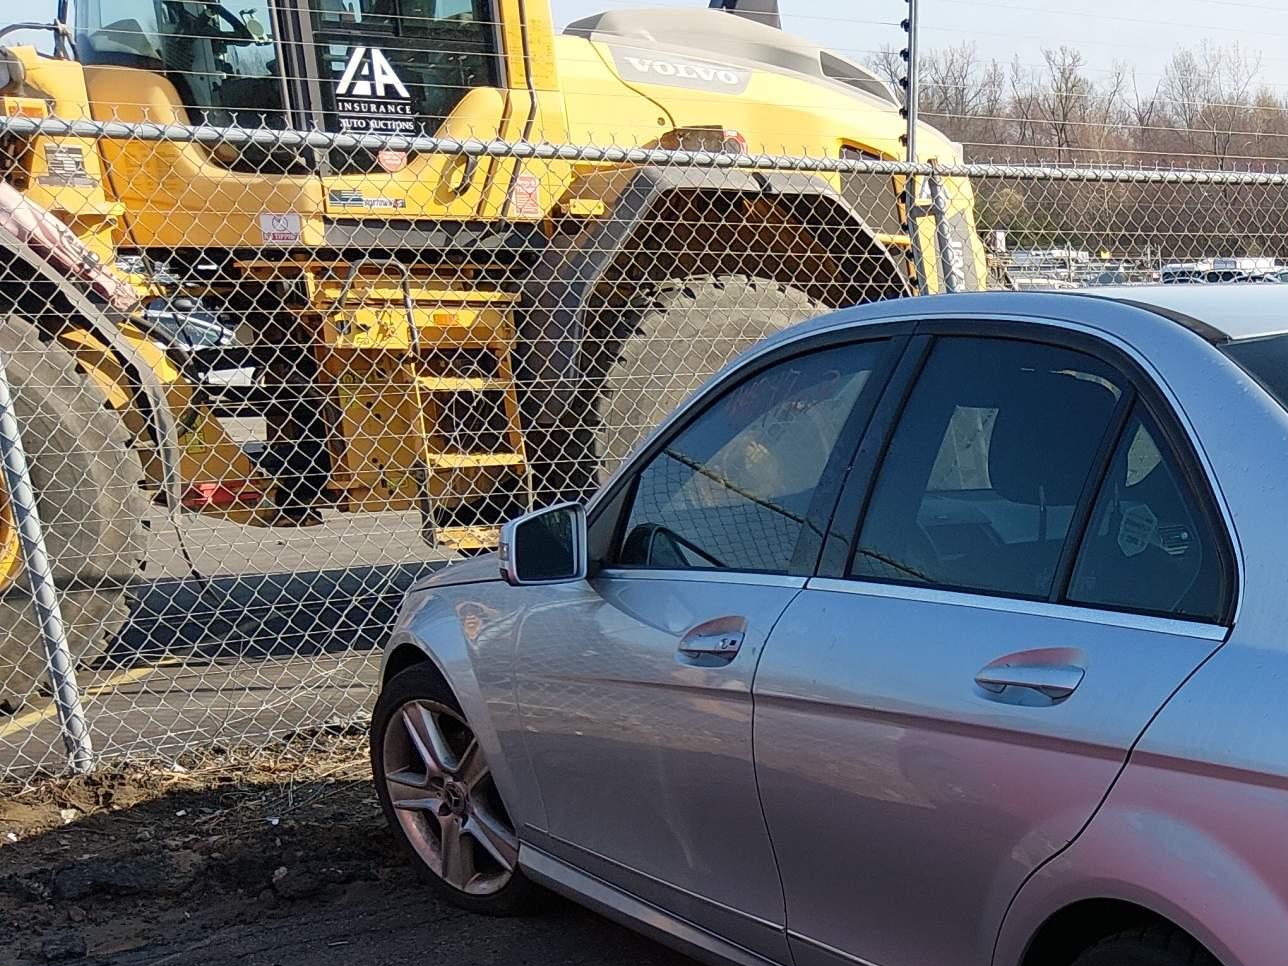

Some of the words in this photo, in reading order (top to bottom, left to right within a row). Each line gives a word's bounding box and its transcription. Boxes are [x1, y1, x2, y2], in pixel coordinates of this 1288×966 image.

[623, 56, 739, 85] VOLVO
[338, 102, 412, 114] INSURANCE
[340, 118, 366, 128] AUTO
[371, 119, 414, 130] AUCTIONS
